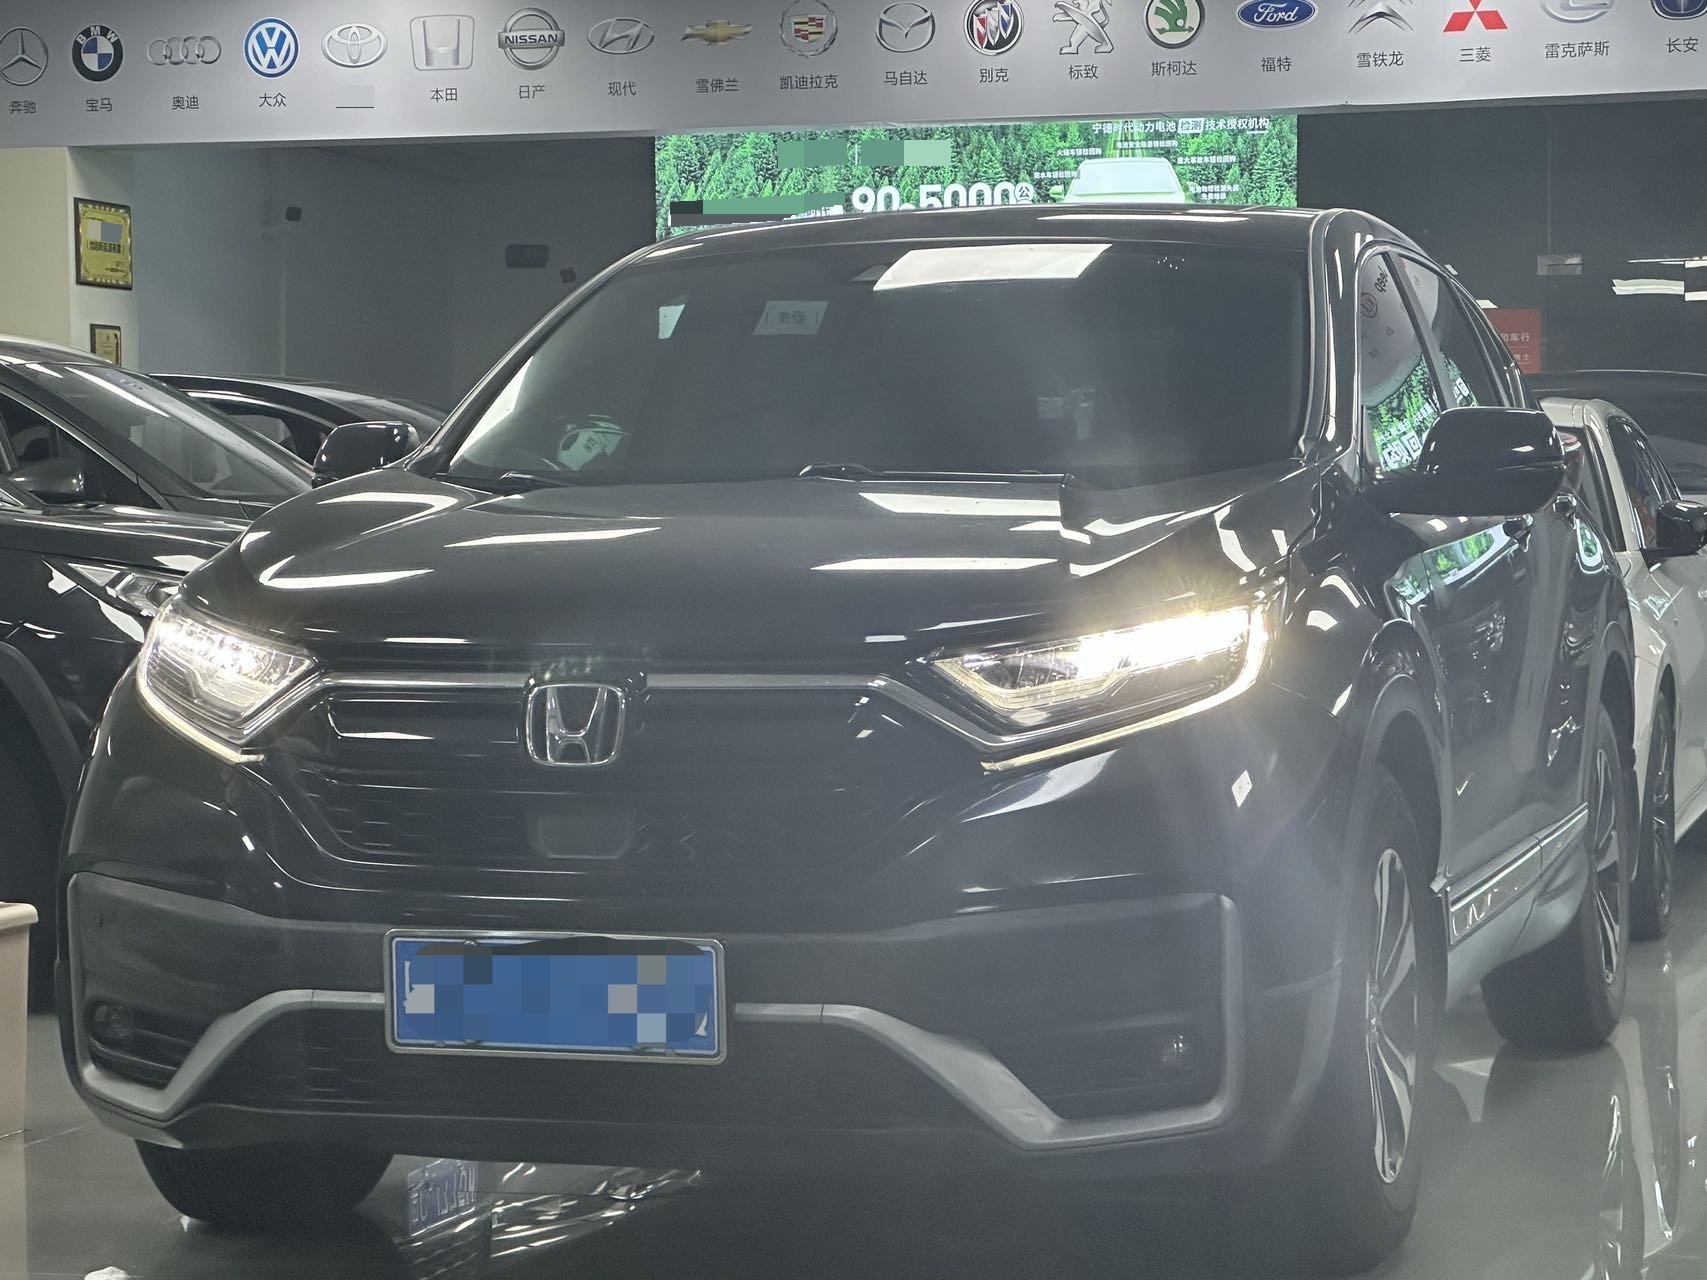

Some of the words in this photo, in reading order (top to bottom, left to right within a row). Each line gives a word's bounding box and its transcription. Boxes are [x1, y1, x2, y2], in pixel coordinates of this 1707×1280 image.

[1253, 2, 1300, 22] Ford
[76, 25, 119, 45] BMW
[504, 34, 558, 44] NISSAN
[1545, 40, 1611, 58] 雷克萨斯
[1666, 37, 1699, 53] 长安
[1356, 51, 1405, 68] 雪铁龙
[1459, 46, 1492, 62] 三菱
[1068, 64, 1098, 80] 标致
[1151, 60, 1198, 76] 斯柯达
[1261, 56, 1293, 72] 福特
[779, 74, 839, 90] 凯迪拉克
[883, 70, 929, 86] 马自达
[979, 67, 1010, 83] 别克
[519, 85, 545, 99] 日产
[608, 81, 637, 96] 现代
[695, 78, 739, 93] 雪佛兰
[172, 96, 200, 110] 奥迪
[259, 92, 287, 108] 大众
[430, 88, 458, 102] 本田
[9, 101, 37, 114] 奔驰
[86, 97, 113, 112] 宝马
